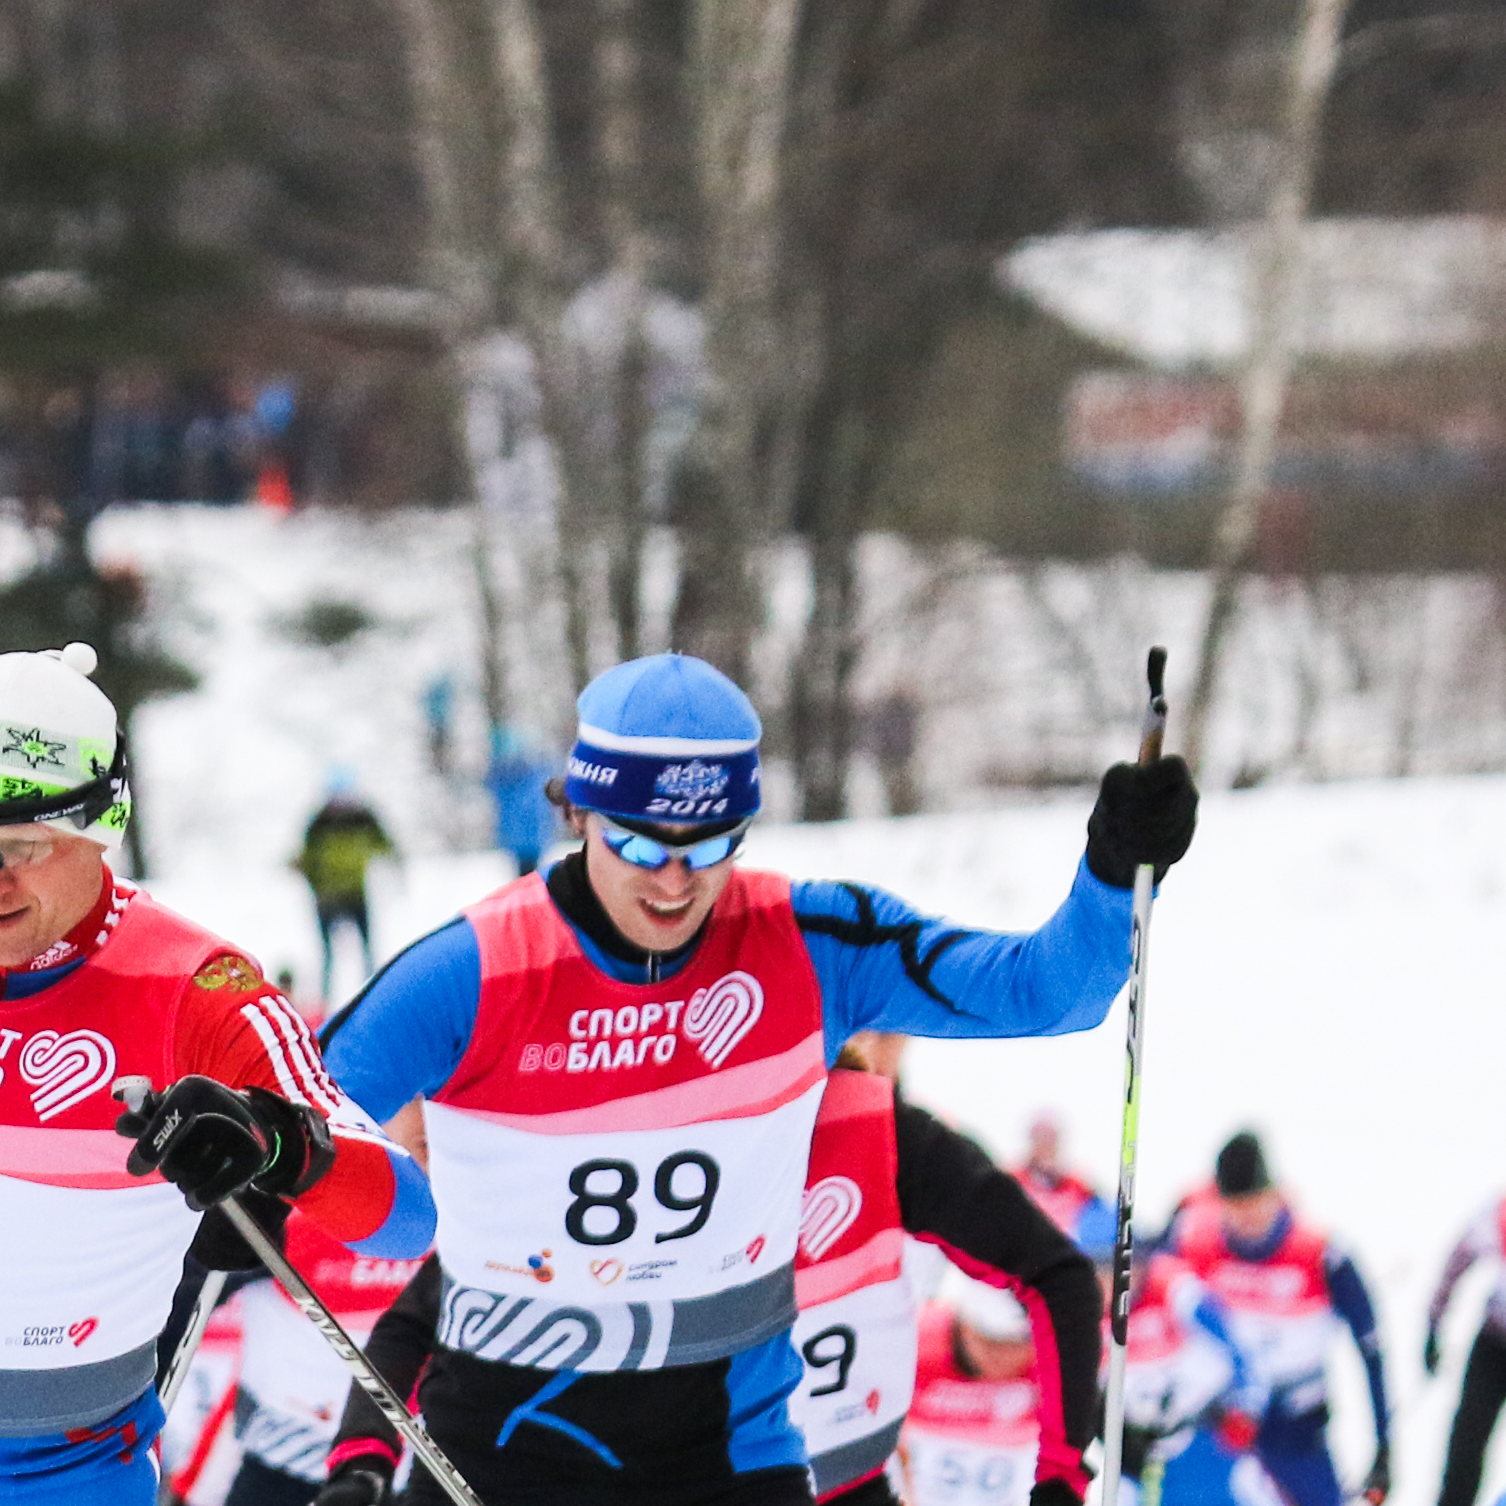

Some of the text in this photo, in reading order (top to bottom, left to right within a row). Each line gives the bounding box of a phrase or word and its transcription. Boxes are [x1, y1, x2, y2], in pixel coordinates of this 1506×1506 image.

[569, 1000, 685, 1040] СПОРТ
[565, 1149, 722, 1246] 89
[23, 1325, 66, 1338] СПОРТ
